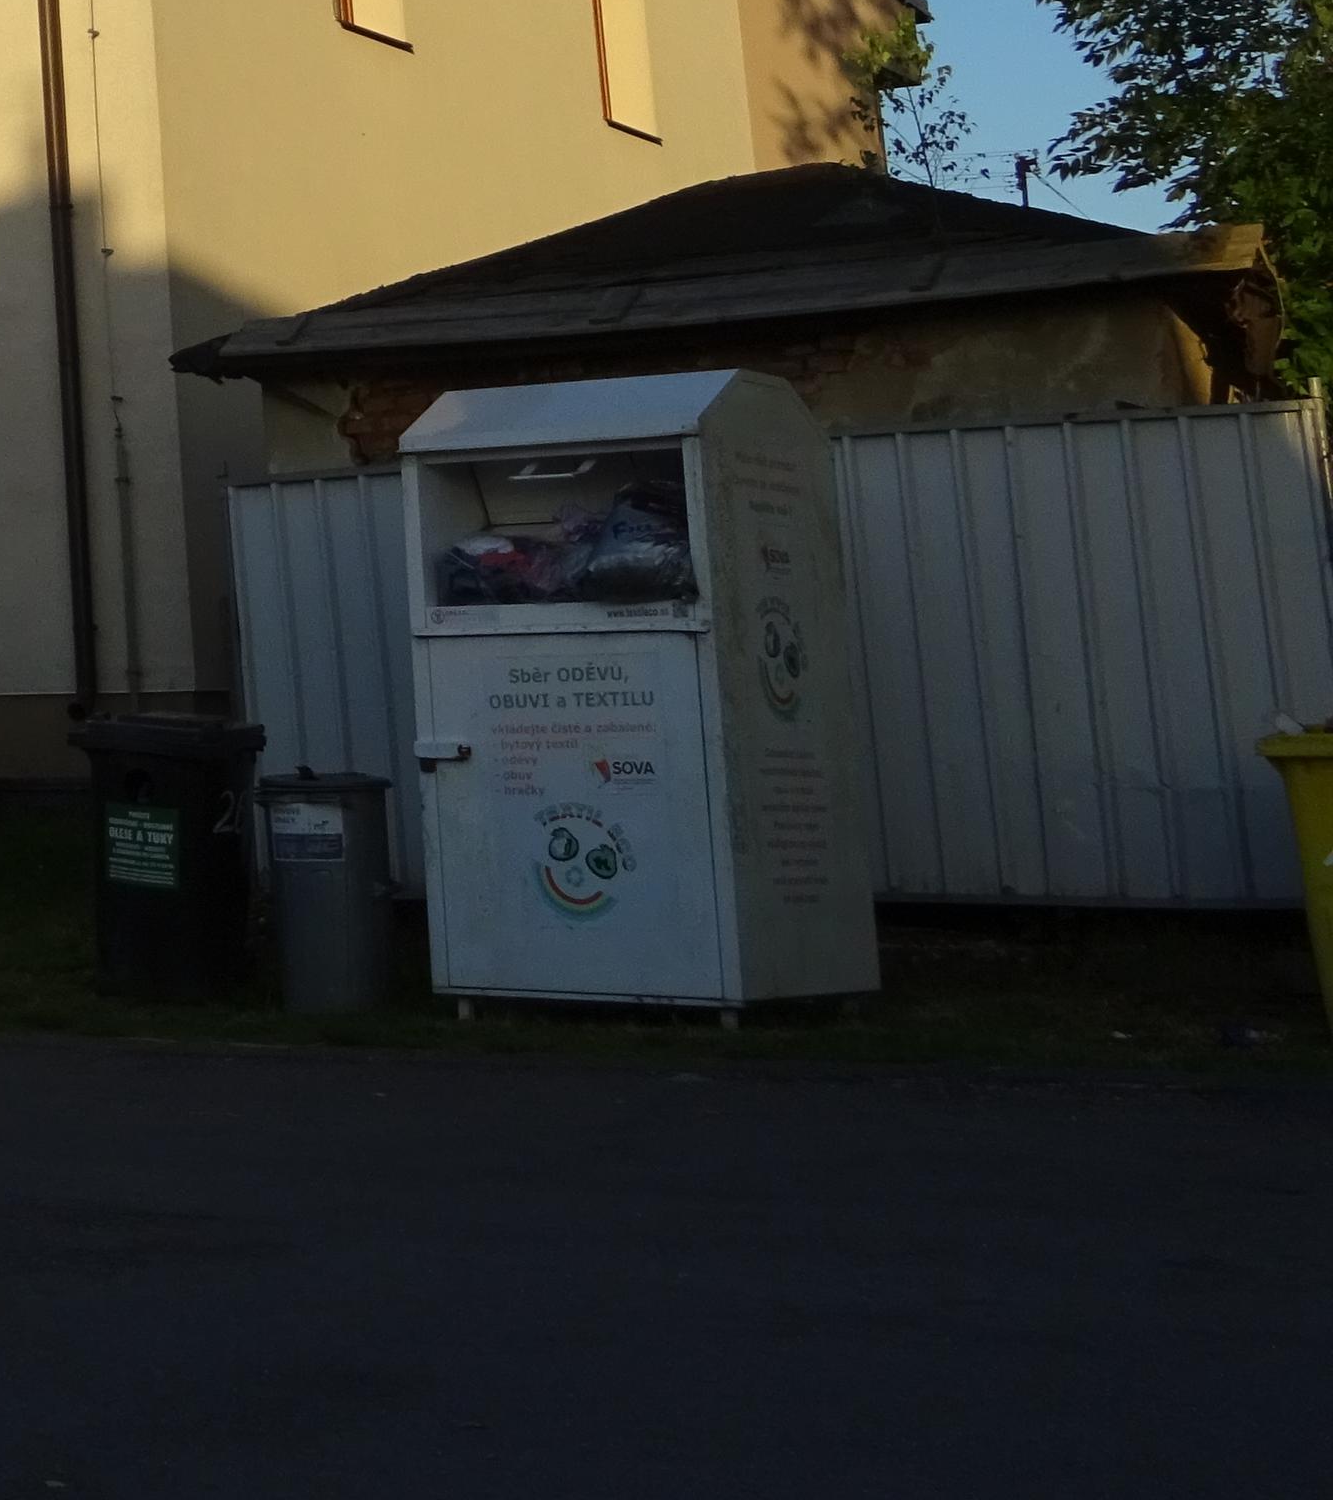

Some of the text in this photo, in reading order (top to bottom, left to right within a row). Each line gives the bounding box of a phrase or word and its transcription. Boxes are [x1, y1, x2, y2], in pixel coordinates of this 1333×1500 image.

[489, 690, 655, 709] OBUVI a TEXTILU
[612, 760, 656, 776] SOVA
